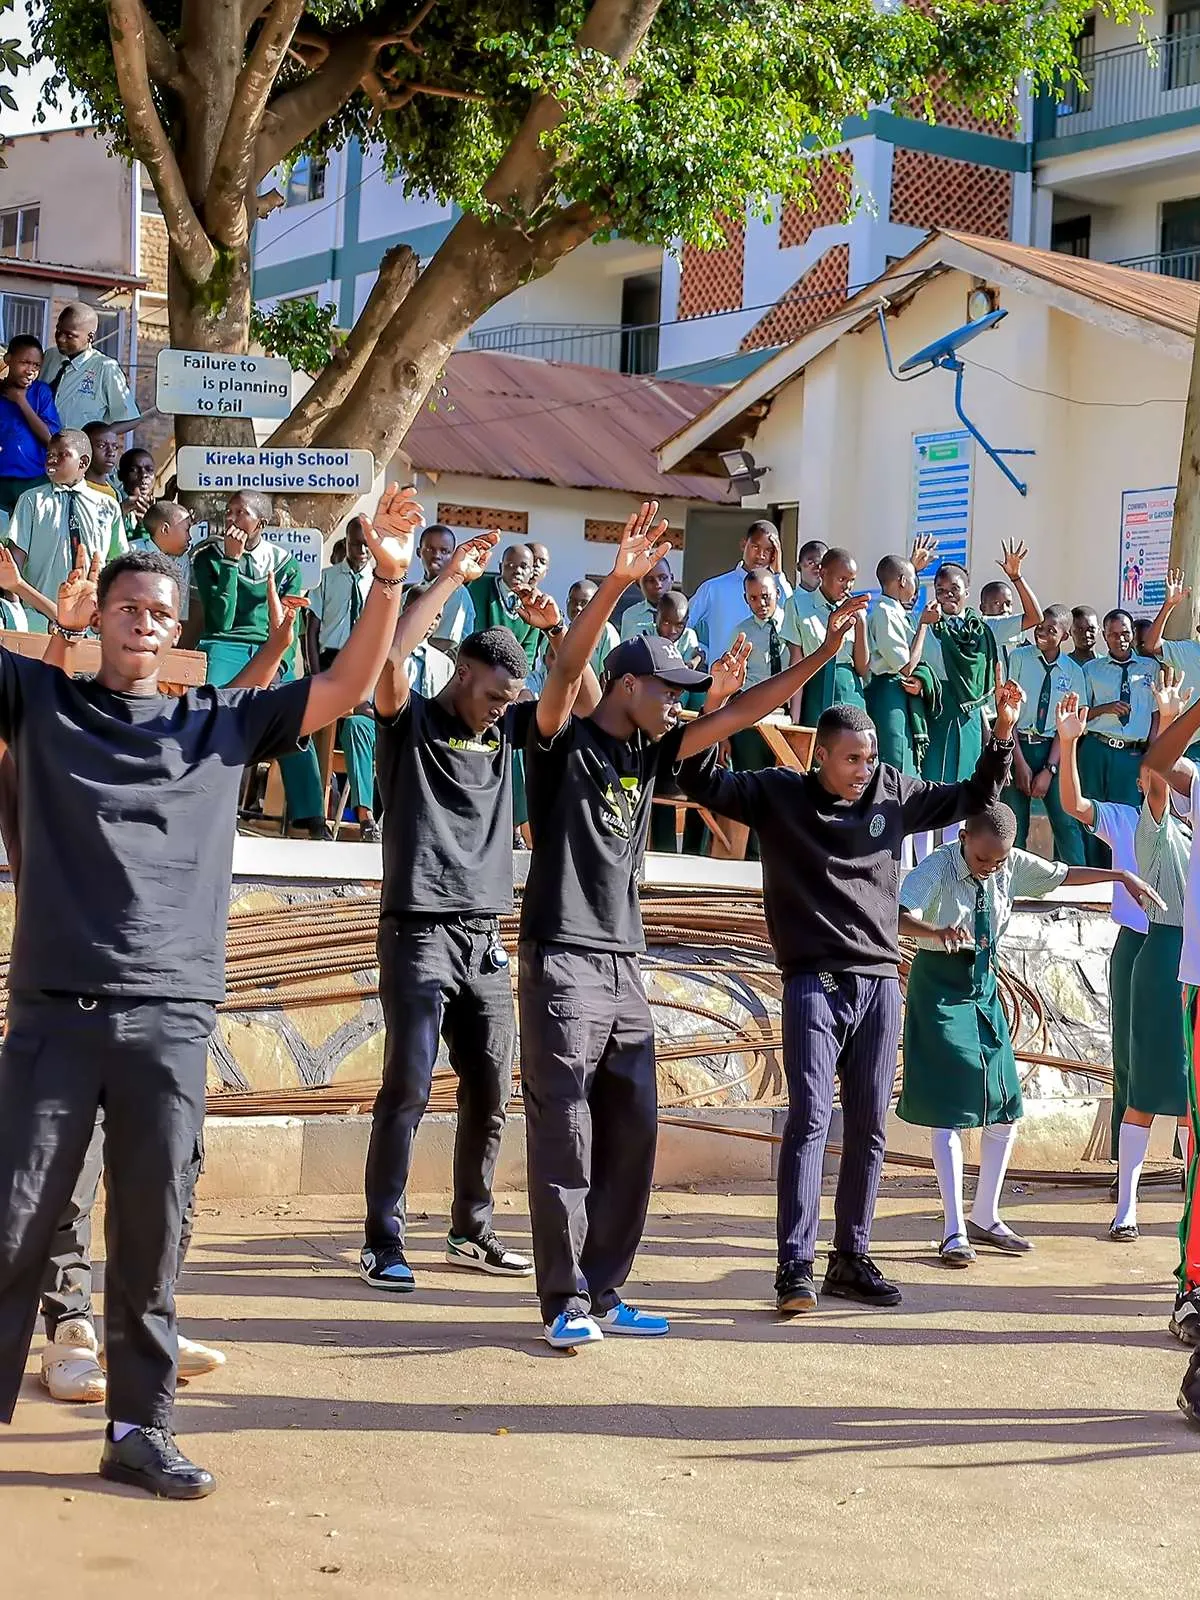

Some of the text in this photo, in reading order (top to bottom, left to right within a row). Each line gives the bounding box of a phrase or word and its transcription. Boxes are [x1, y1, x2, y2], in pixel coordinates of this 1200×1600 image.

[183, 355, 257, 373] Failure to
[203, 376, 215, 390] is
[218, 377, 288, 397] planning
[197, 398, 242, 413] to fail
[206, 453, 349, 469] Kireka High School
[198, 473, 359, 488] is an Inclusive School
[287, 530, 311, 544] the
